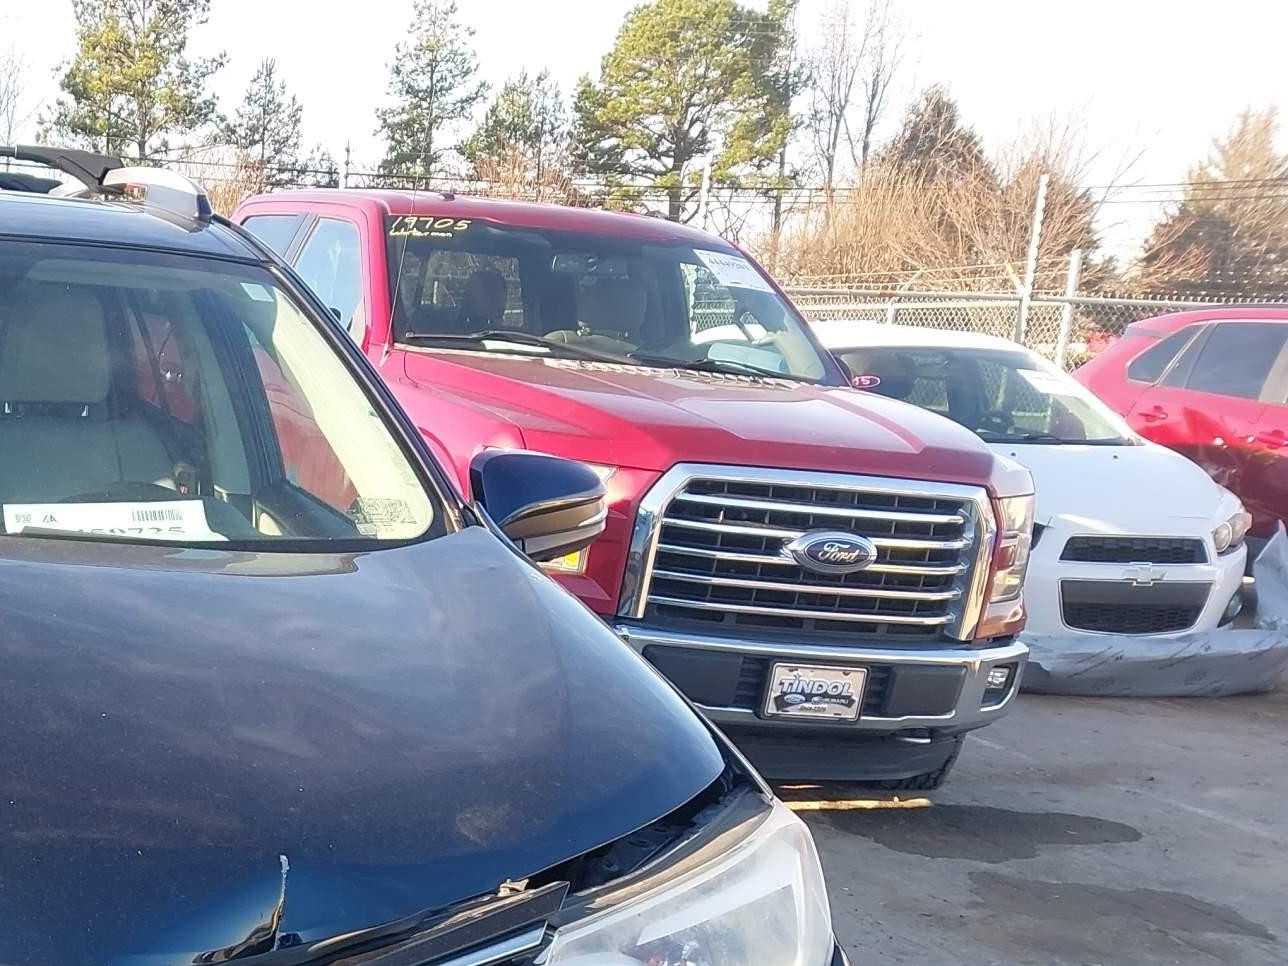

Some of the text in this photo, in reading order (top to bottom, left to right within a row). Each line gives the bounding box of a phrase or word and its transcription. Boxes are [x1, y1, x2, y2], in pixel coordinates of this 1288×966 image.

[392, 216, 472, 230] 19705
[818, 542, 860, 563] Ford
[779, 678, 853, 697] TINDOL
